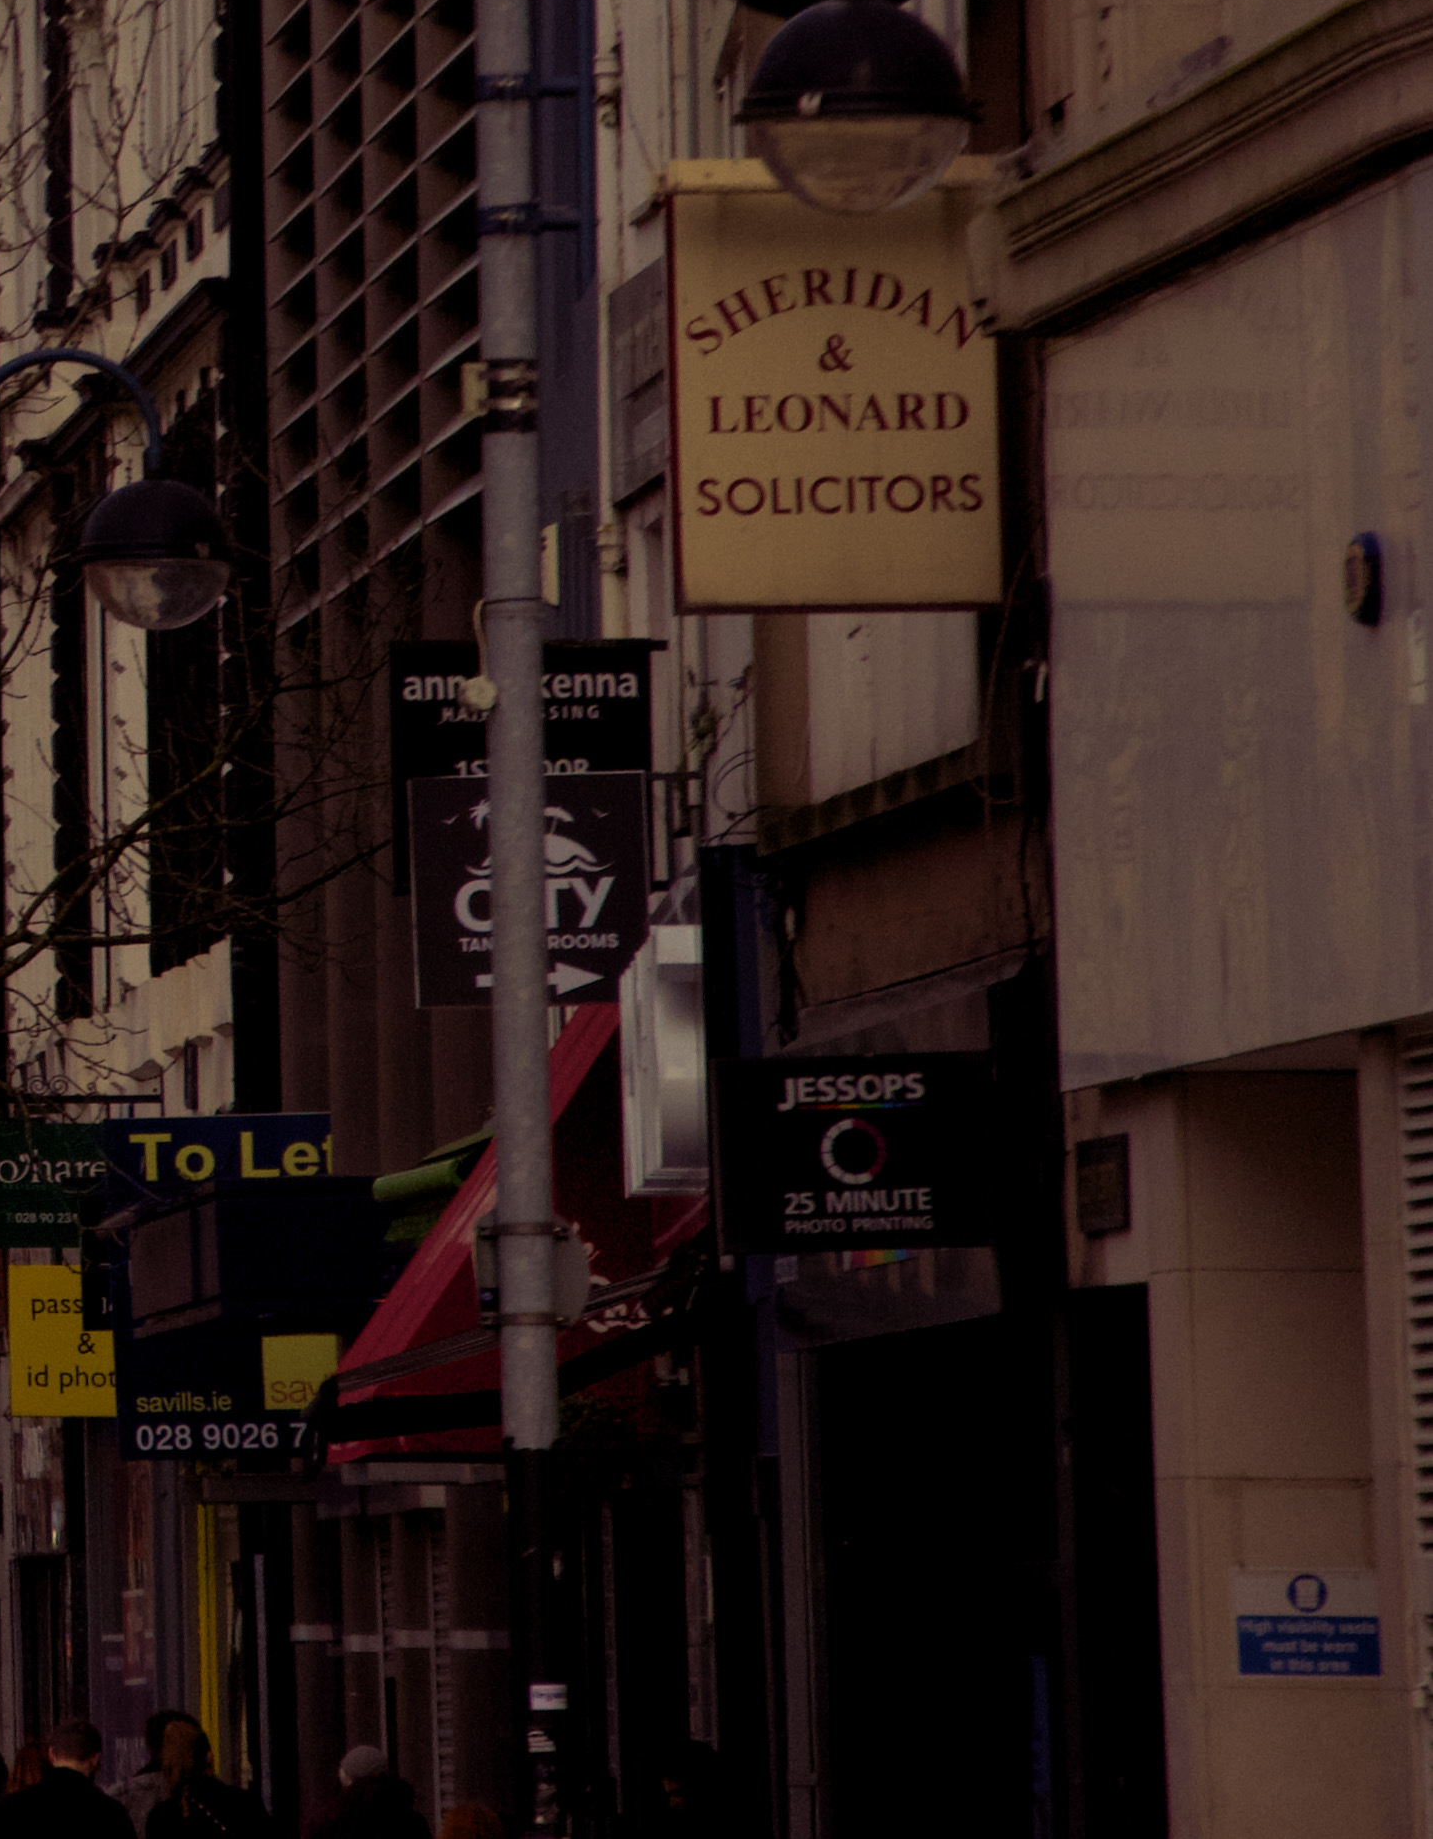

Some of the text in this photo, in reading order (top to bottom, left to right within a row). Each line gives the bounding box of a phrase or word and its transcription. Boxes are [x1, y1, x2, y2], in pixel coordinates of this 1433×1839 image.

[686, 267, 997, 355] SHERIDAN
[818, 333, 853, 372] &
[709, 392, 970, 434] LEONARD
[698, 473, 983, 515] SOLICITORS
[454, 865, 617, 933] CTY
[547, 933, 620, 950] ROOMS
[775, 1071, 928, 1112] JESSOPS
[128, 1129, 333, 1182] To Let
[783, 1186, 934, 1215] 25 MINUTE
[783, 1214, 936, 1235] PHOTO PRINTING
[77, 1332, 96, 1355] &
[27, 1364, 117, 1394] id phot
[135, 1389, 233, 1412] savills.ie
[135, 1422, 194, 1451] 028
[201, 1420, 281, 1451] 9026
